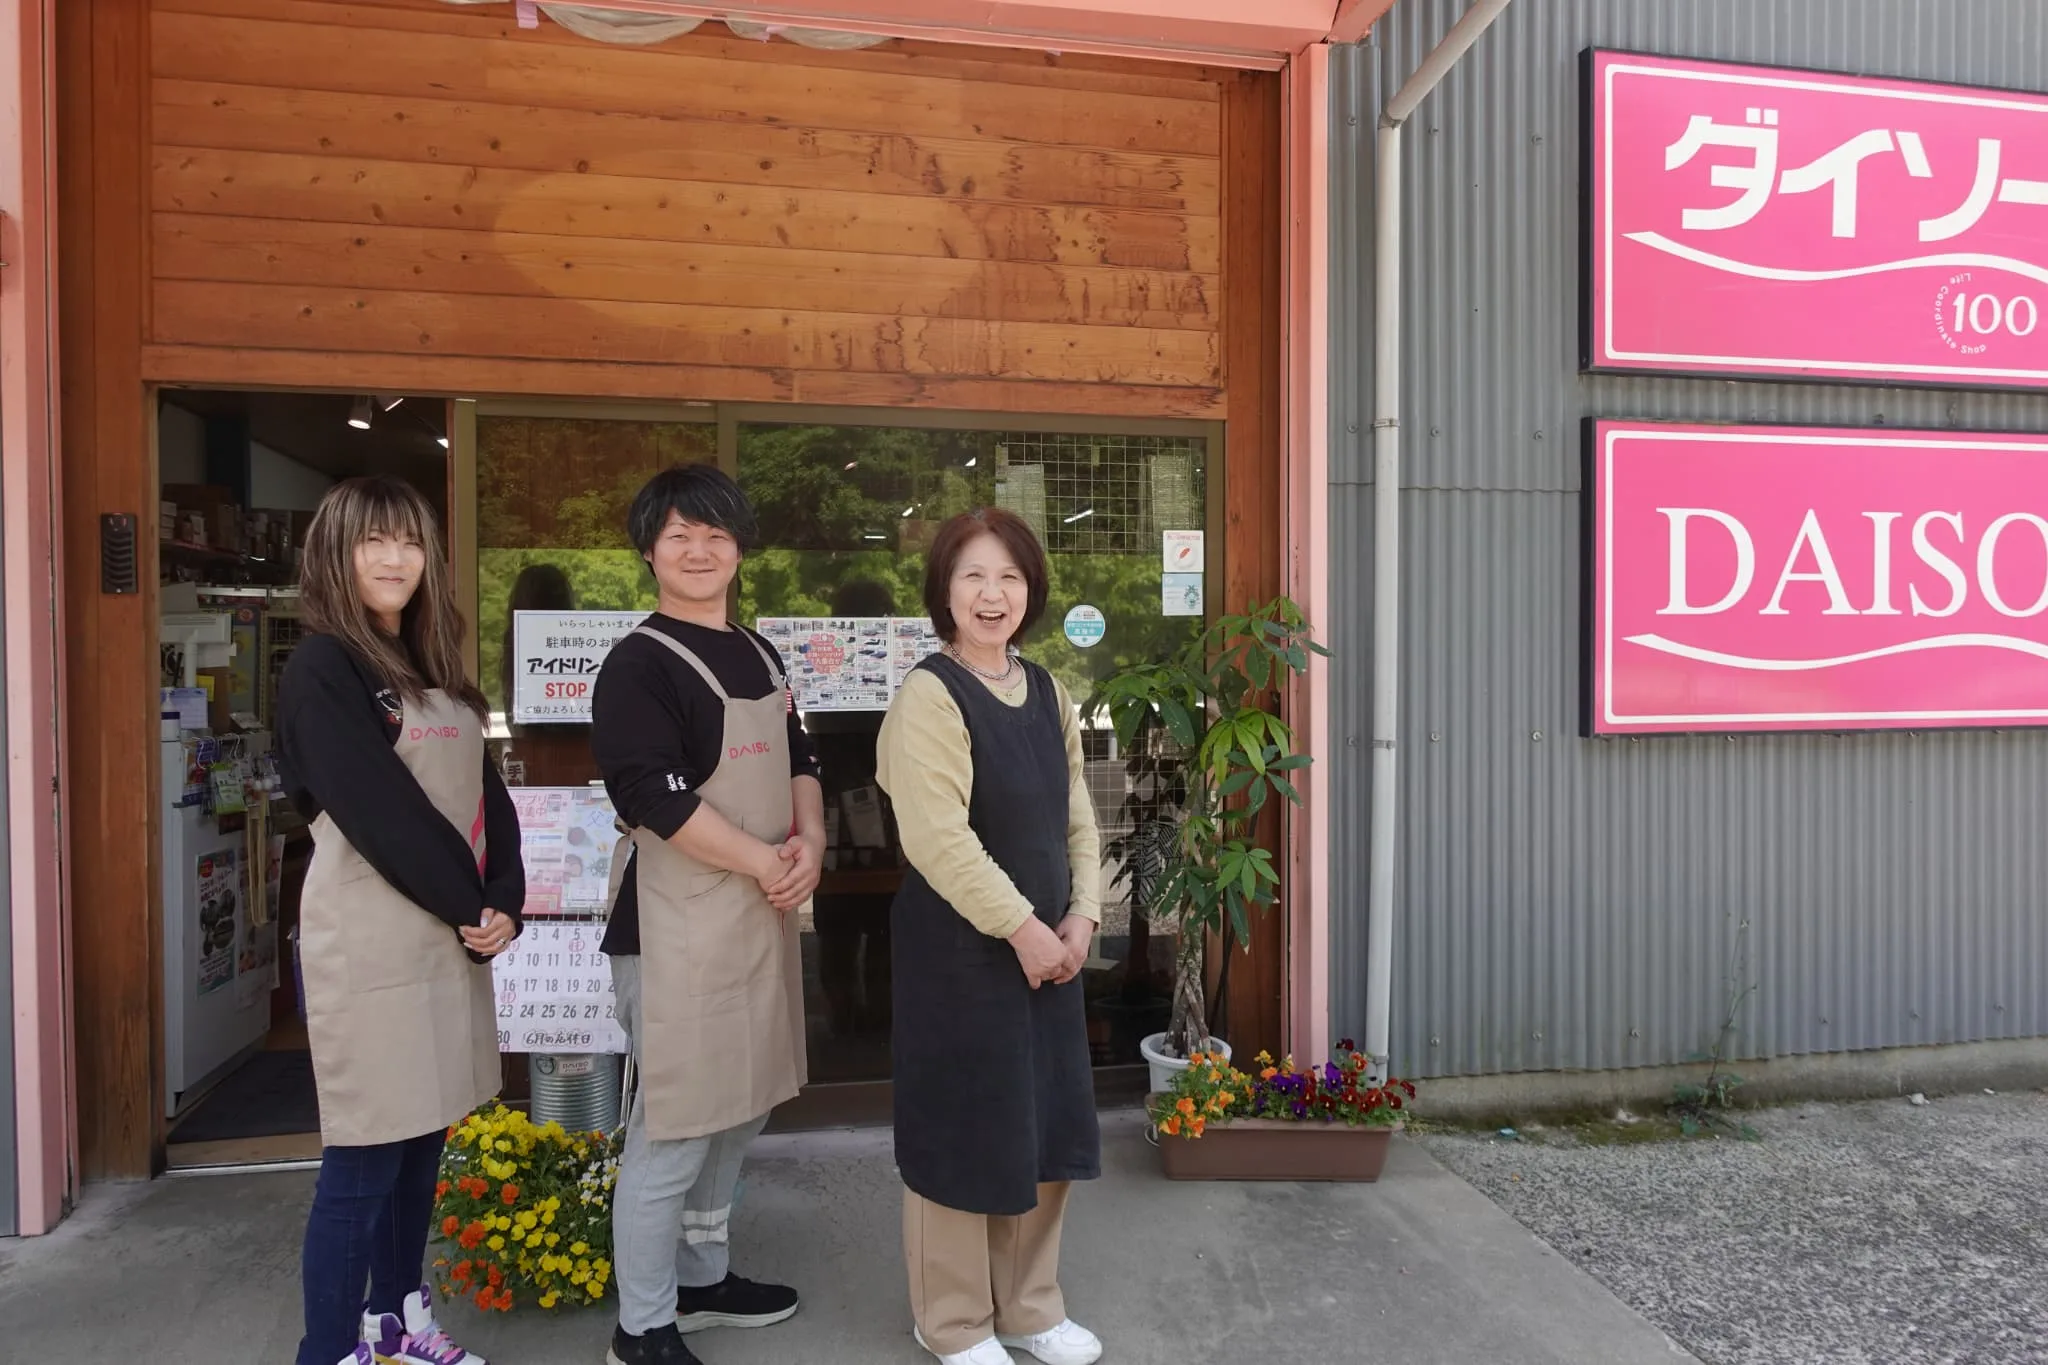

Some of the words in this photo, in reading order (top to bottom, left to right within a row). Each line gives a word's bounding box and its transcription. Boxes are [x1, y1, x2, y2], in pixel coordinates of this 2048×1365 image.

[1952, 292, 2038, 336] 100
[1656, 507, 2048, 618] DAISO
[559, 619, 635, 629] いらっしゃいませ
[545, 682, 588, 698] STOP
[409, 726, 461, 741] DAISO
[728, 741, 771, 760] DAISO
[531, 928, 538, 941] 3
[552, 928, 560, 941] 4
[574, 927, 581, 940] 5
[595, 927, 602, 941] 6
[507, 953, 515, 966] 9
[526, 953, 540, 967] 10
[547, 953, 560, 967] 11
[569, 953, 582, 967] 12
[590, 953, 604, 967] 13
[503, 979, 516, 991] 16
[524, 979, 538, 991] 17
[546, 979, 558, 992] 18
[567, 979, 580, 992] 19
[586, 979, 601, 992] 20
[498, 1004, 513, 1018] 23
[519, 1004, 534, 1018] 24
[541, 1004, 556, 1018] 25
[562, 1004, 577, 1018] 26
[583, 1004, 599, 1018] 27
